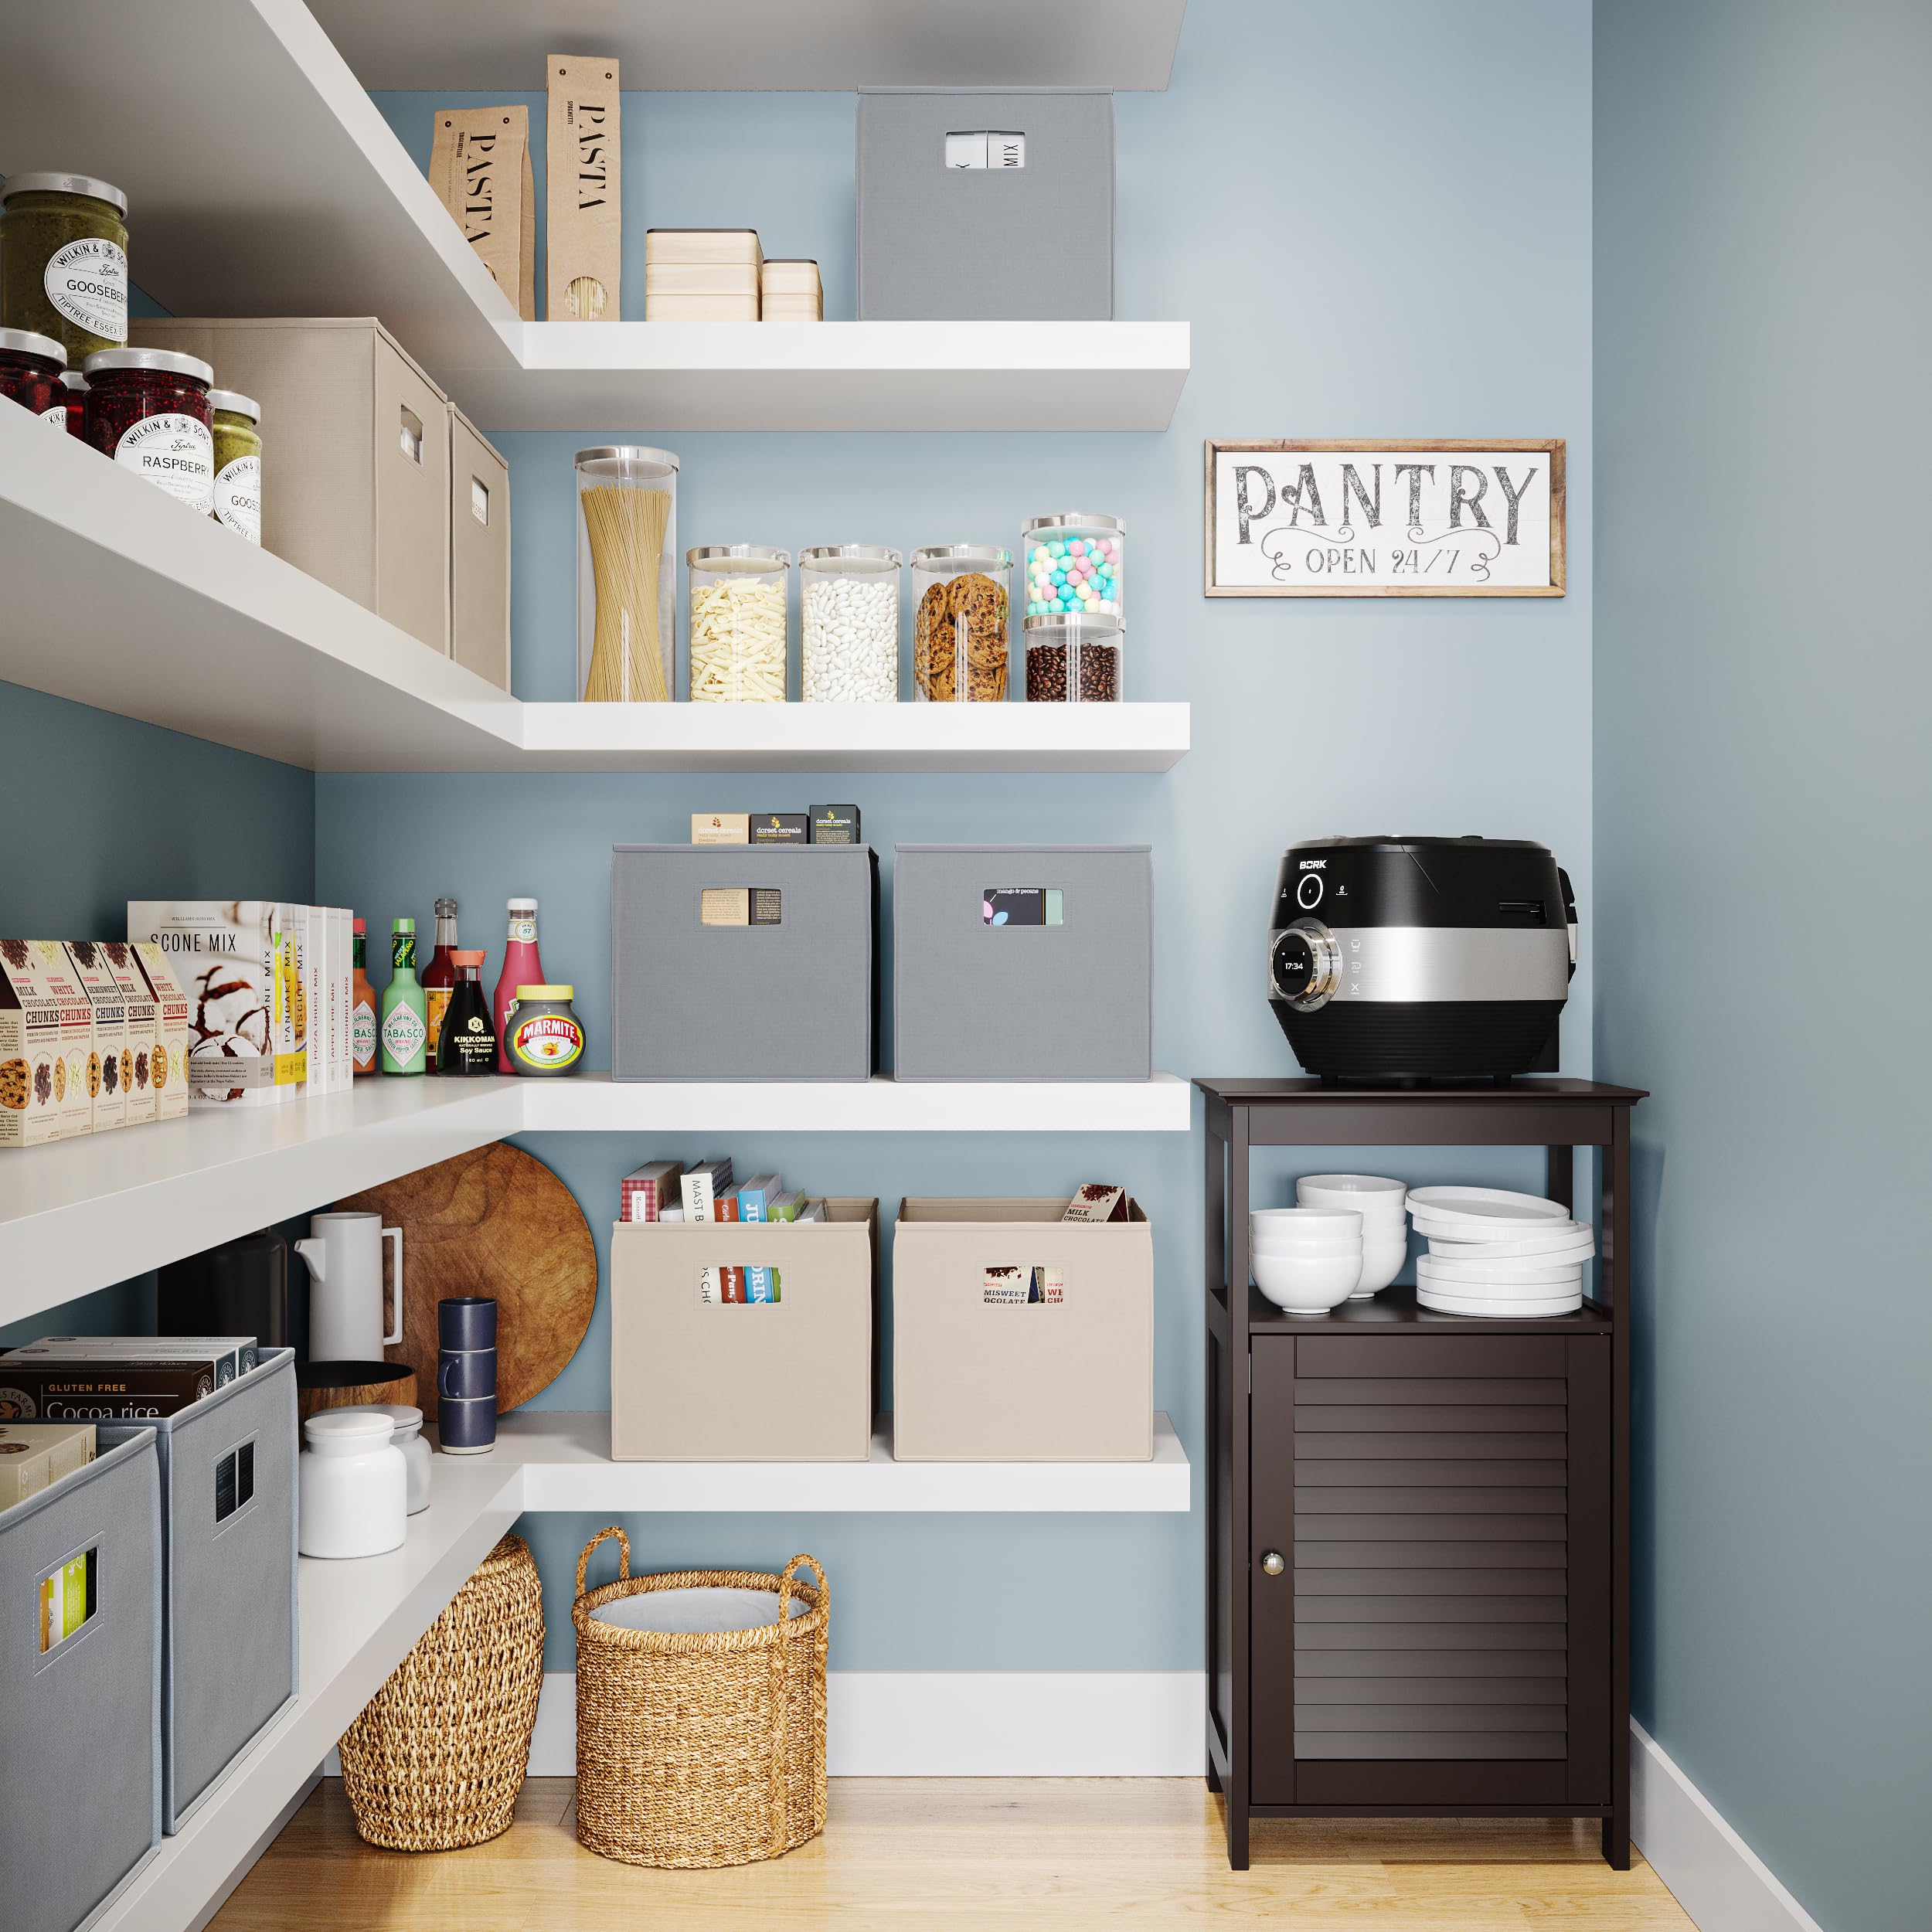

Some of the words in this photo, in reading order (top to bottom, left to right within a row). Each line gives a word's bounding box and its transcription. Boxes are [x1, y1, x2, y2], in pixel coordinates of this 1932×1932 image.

[456, 131, 464, 158] TAGLIATELLE
[579, 104, 607, 212] PASTA
[1003, 145, 1019, 166] MIX
[465, 130, 497, 243] PASTA
[56, 244, 90, 266] WILKIN
[93, 243, 99, 253] &
[58, 295, 91, 325] TIPTREE
[126, 420, 161, 445] WILKIN
[164, 420, 171, 428] &
[143, 455, 209, 477] RASPBERRY
[223, 462, 248, 481] WILKIN
[1232, 461, 1539, 546] PANTRY
[224, 511, 248, 537] TIPTREE
[1305, 548, 1376, 573] OPEN
[1391, 548, 1461, 573] 24/7
[1299, 859, 1328, 870] BORK
[209, 934, 236, 952] MIX
[15, 986, 37, 996] MILK
[50, 985, 75, 995] WHITE
[87, 985, 118, 994] SEMISWEET
[119, 984, 136, 992] MILK
[22, 998, 58, 1008] CHOCOLATE
[56, 997, 90, 1005] CHOCOLATE
[125, 995, 154, 1003] CHOCOLATE
[26, 1010, 60, 1023] CHUNKS
[60, 1009, 91, 1022] CHUNKS
[96, 1006, 124, 1019] CHUNKS
[128, 1005, 155, 1017] CHUNKS
[162, 1004, 188, 1015] CHUNKS
[383, 1029, 423, 1038] TABASCO
[692, 1180, 704, 1211] MAST
[11, 1391, 32, 1413] FARM
[46, 1402, 114, 1419] Cocoa
[121, 1402, 159, 1419] rice
